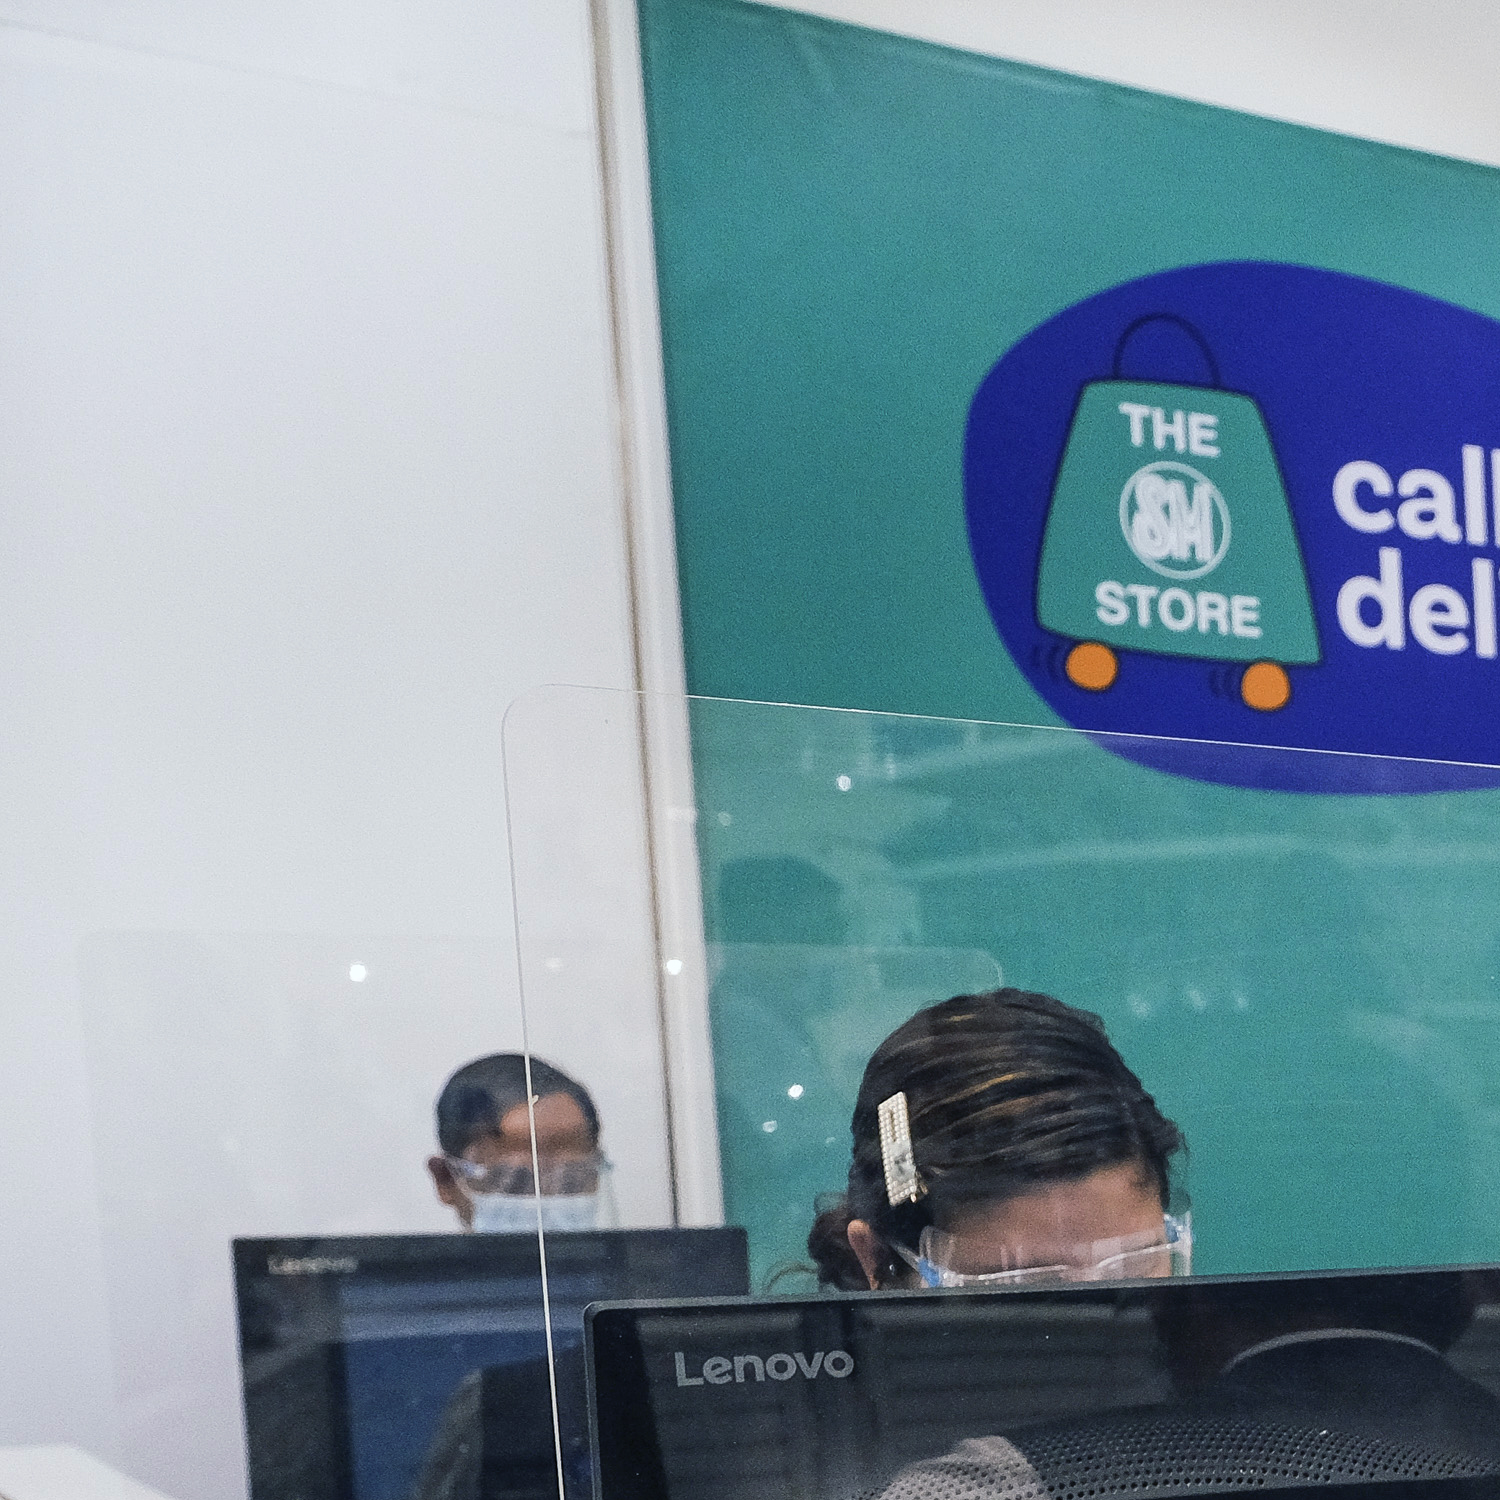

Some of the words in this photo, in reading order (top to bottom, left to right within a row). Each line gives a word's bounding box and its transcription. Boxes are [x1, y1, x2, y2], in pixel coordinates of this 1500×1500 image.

[1119, 402, 1221, 458] THE
[1131, 472, 1215, 562] SM
[1095, 580, 1263, 639] STORE
[674, 1350, 855, 1388] Lenovo
